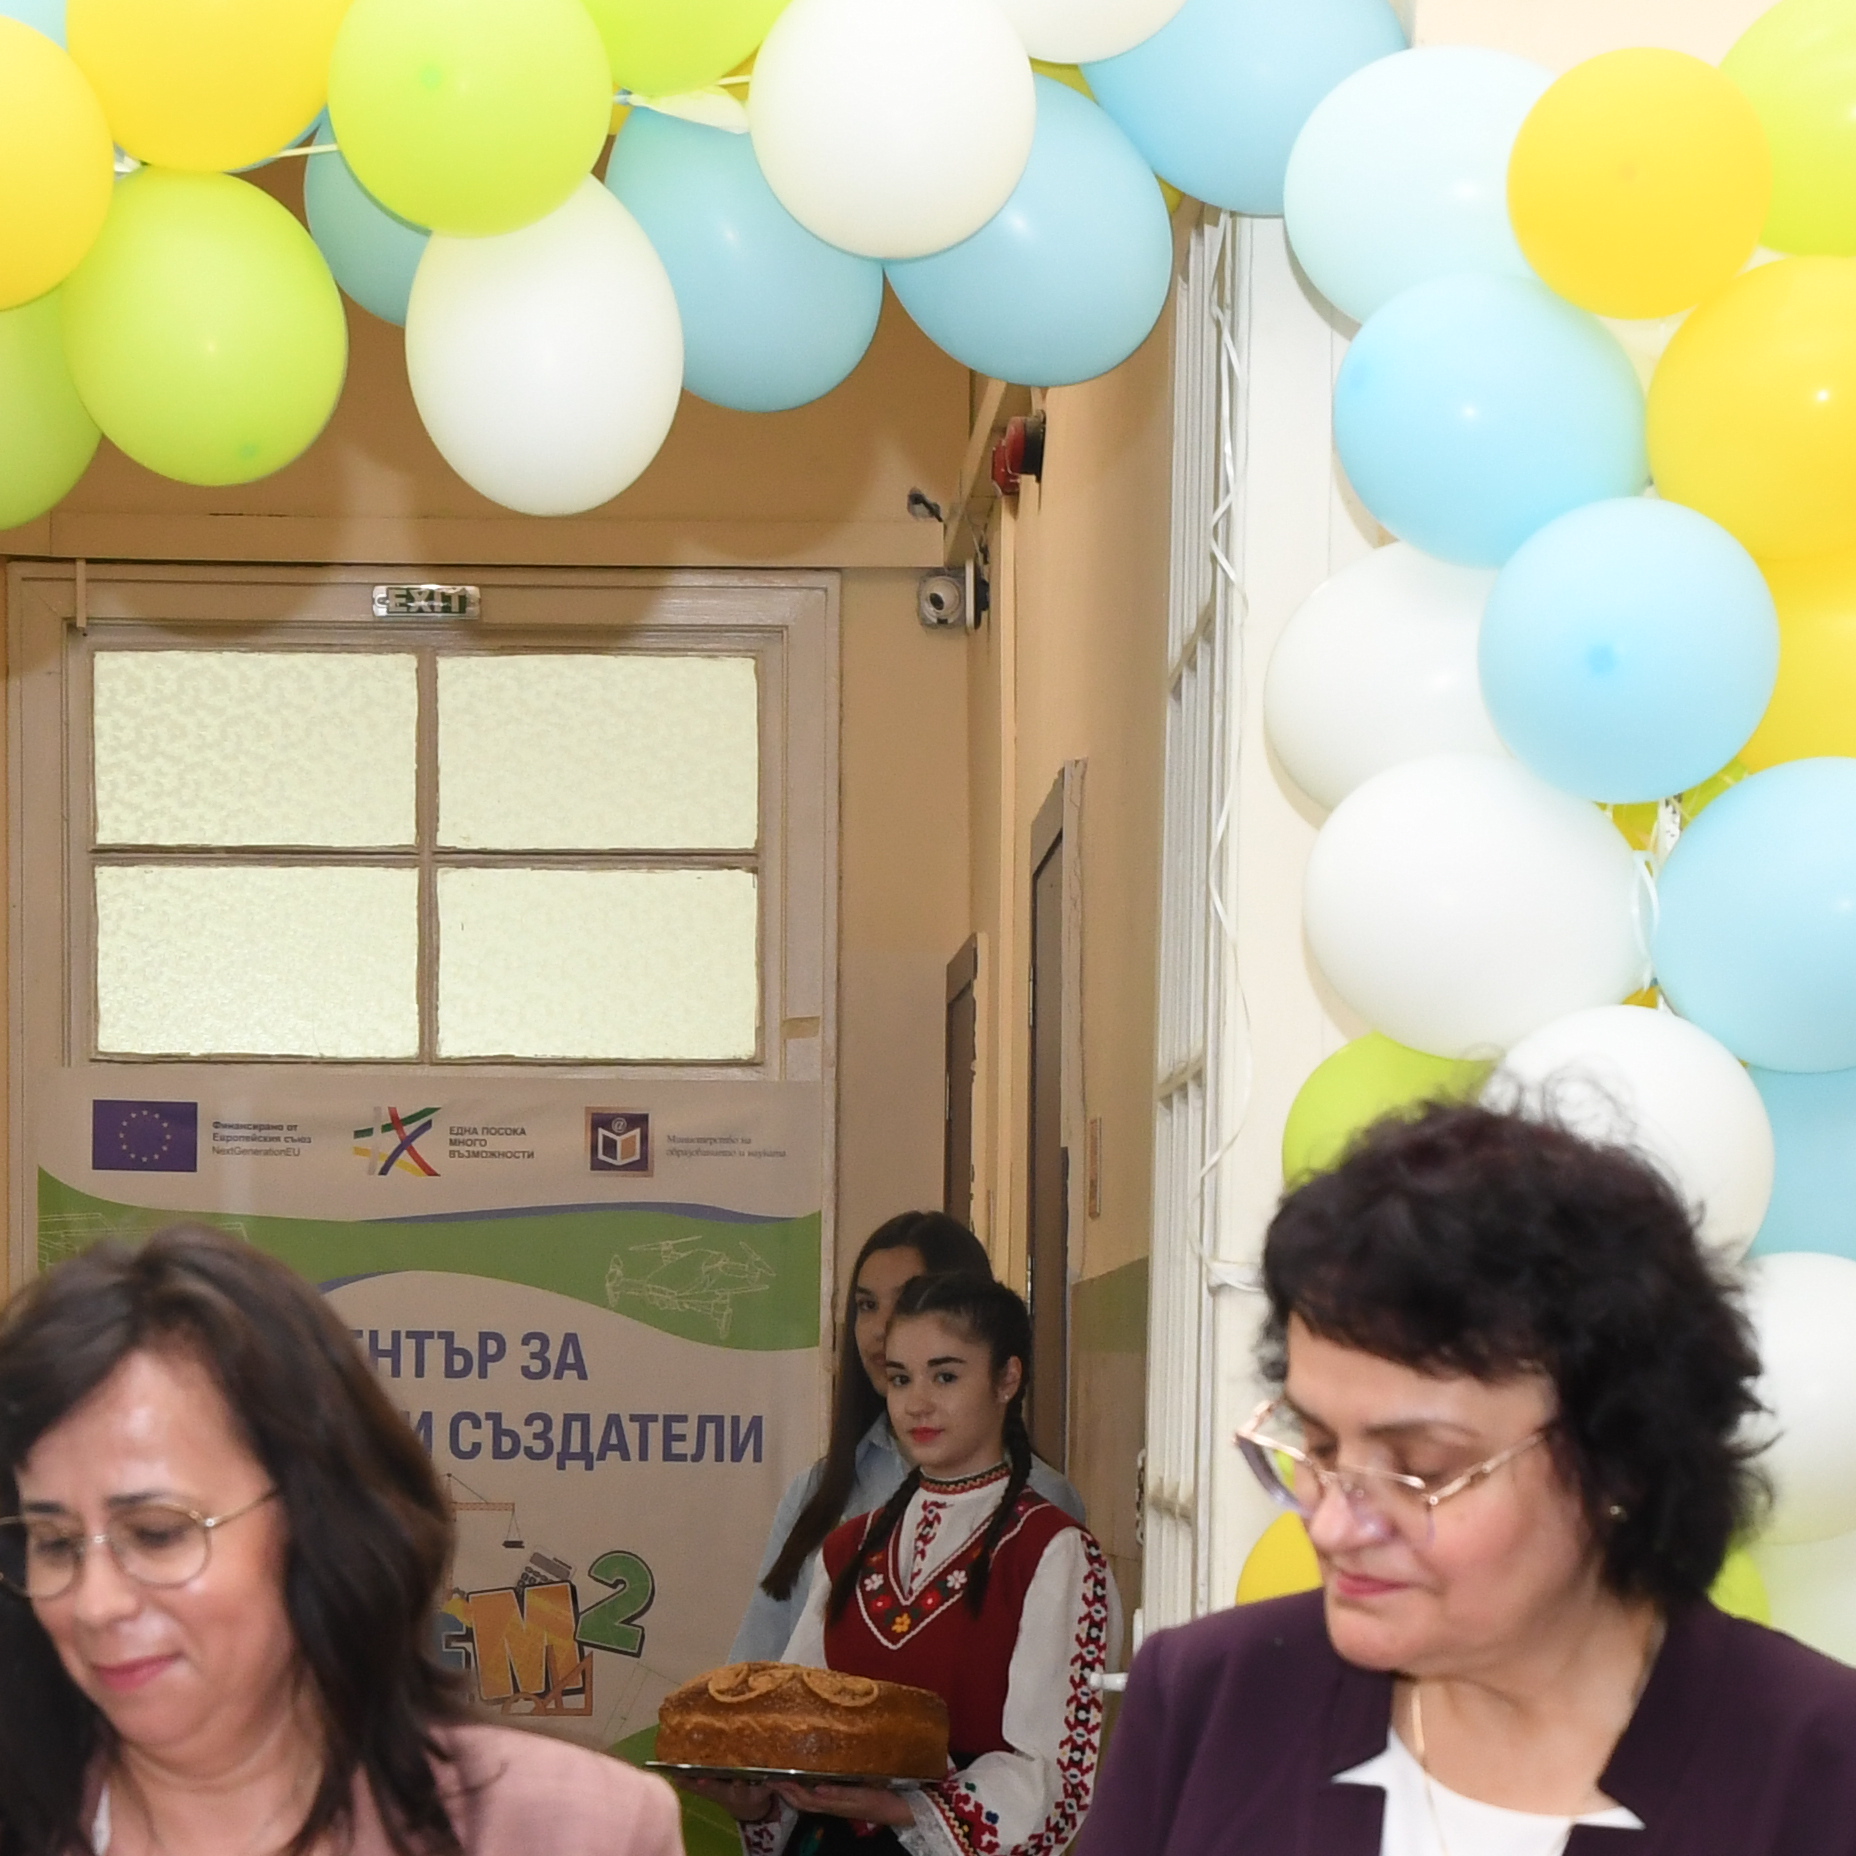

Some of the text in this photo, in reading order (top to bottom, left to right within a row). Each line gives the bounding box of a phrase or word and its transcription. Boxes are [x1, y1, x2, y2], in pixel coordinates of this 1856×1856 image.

[388, 588, 466, 613] EXIT
[449, 1126, 526, 1137] ЕДНА ПОСОКА
[449, 1138, 487, 1148] МНОГО
[449, 1149, 535, 1160] ВЪЗМОЖНОСТИ
[350, 1330, 589, 1381] НТЪР ЗА
[449, 1411, 764, 1471] СЪЗДАТЕЛИ
